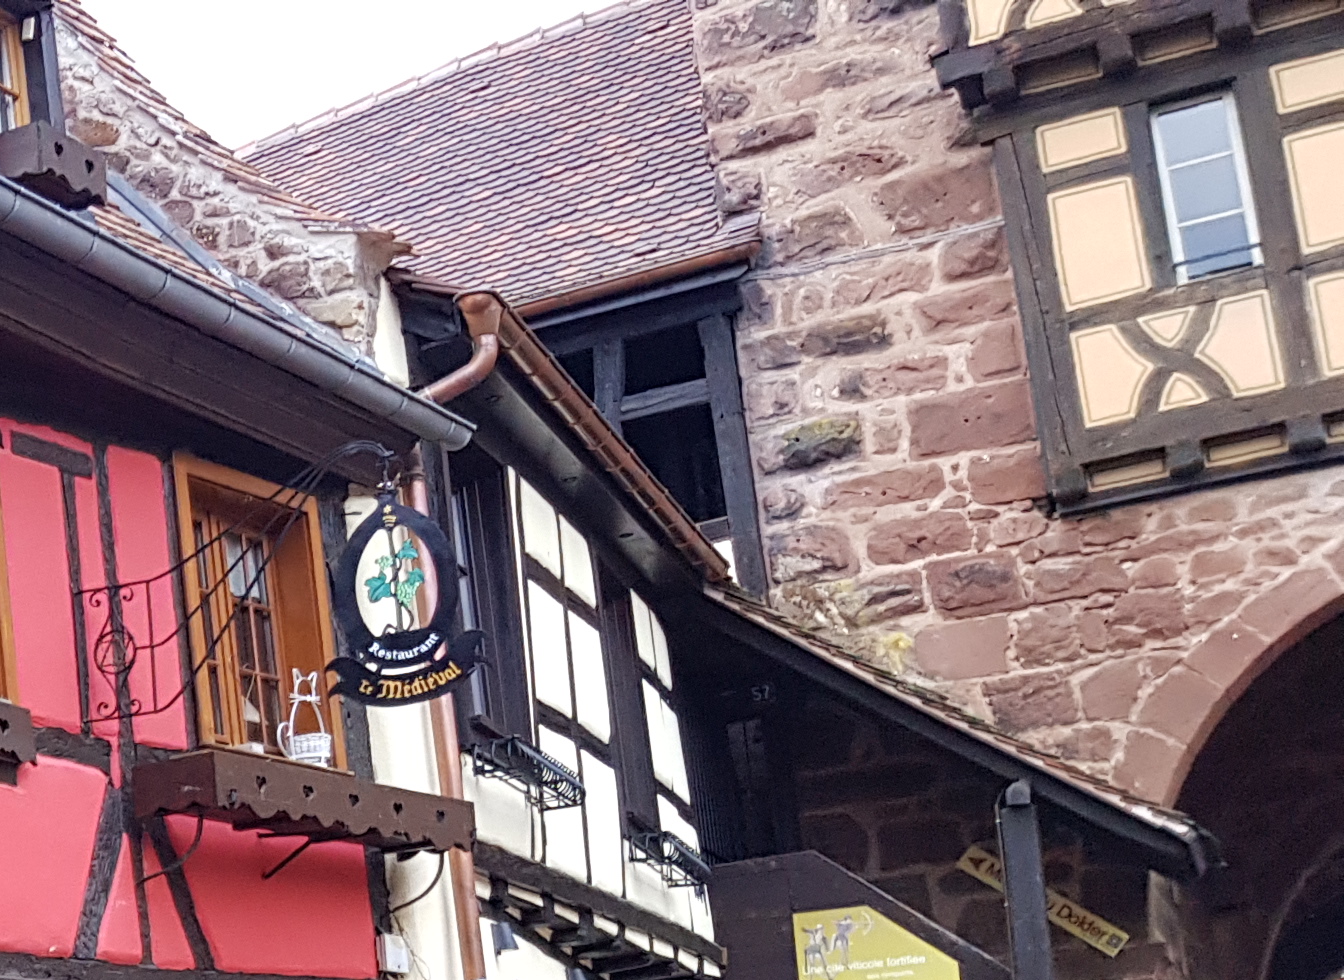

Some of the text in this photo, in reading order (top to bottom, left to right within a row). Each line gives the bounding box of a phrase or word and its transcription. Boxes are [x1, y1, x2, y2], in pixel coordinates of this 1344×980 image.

[368, 633, 440, 660] Restaurant
[376, 661, 462, 699] Médiéval
[1056, 905, 1109, 940] Dolder
